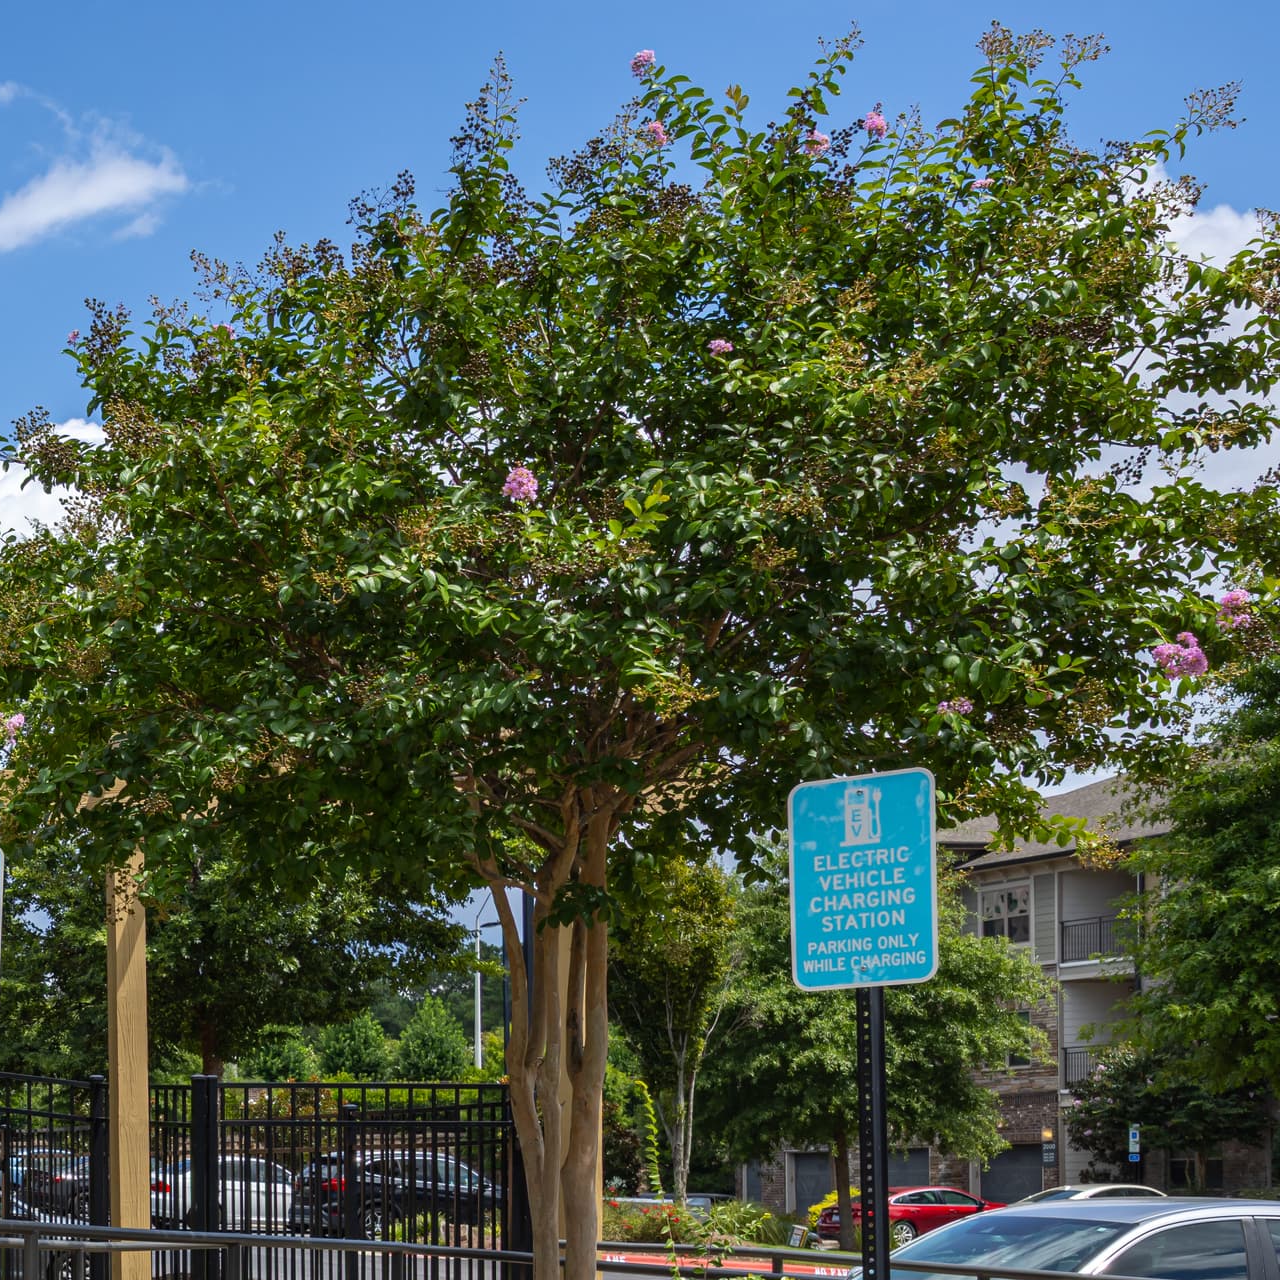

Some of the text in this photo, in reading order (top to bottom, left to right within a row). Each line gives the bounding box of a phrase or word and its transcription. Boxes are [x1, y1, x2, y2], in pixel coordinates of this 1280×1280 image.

[851, 808, 862, 837] EV
[814, 846, 909, 872] ELECTRIC
[819, 868, 906, 892] VEHICLE
[810, 887, 916, 913] CHARGING
[822, 909, 906, 933] STATION
[807, 933, 919, 955] PARKING ONLY
[803, 951, 926, 974] WHILE CHARGING
[831, 1267, 849, 1276] PAR
